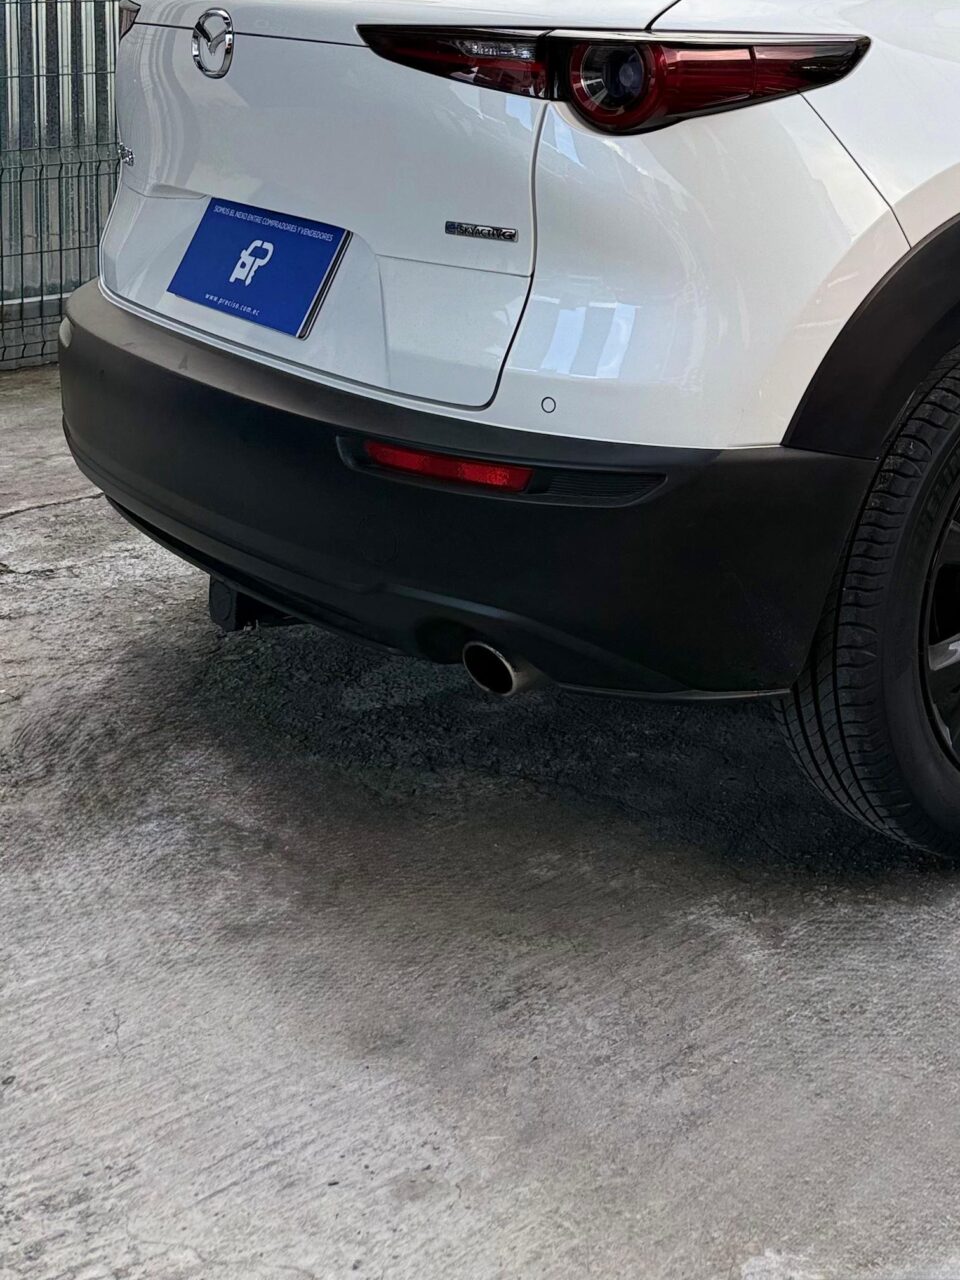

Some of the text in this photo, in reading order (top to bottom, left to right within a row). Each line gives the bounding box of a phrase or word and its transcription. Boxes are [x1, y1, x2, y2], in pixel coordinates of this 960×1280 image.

[213, 204, 231, 216] SOMOS
[262, 217, 298, 233] COMPRADORES
[301, 227, 334, 242] VENDEDORES
